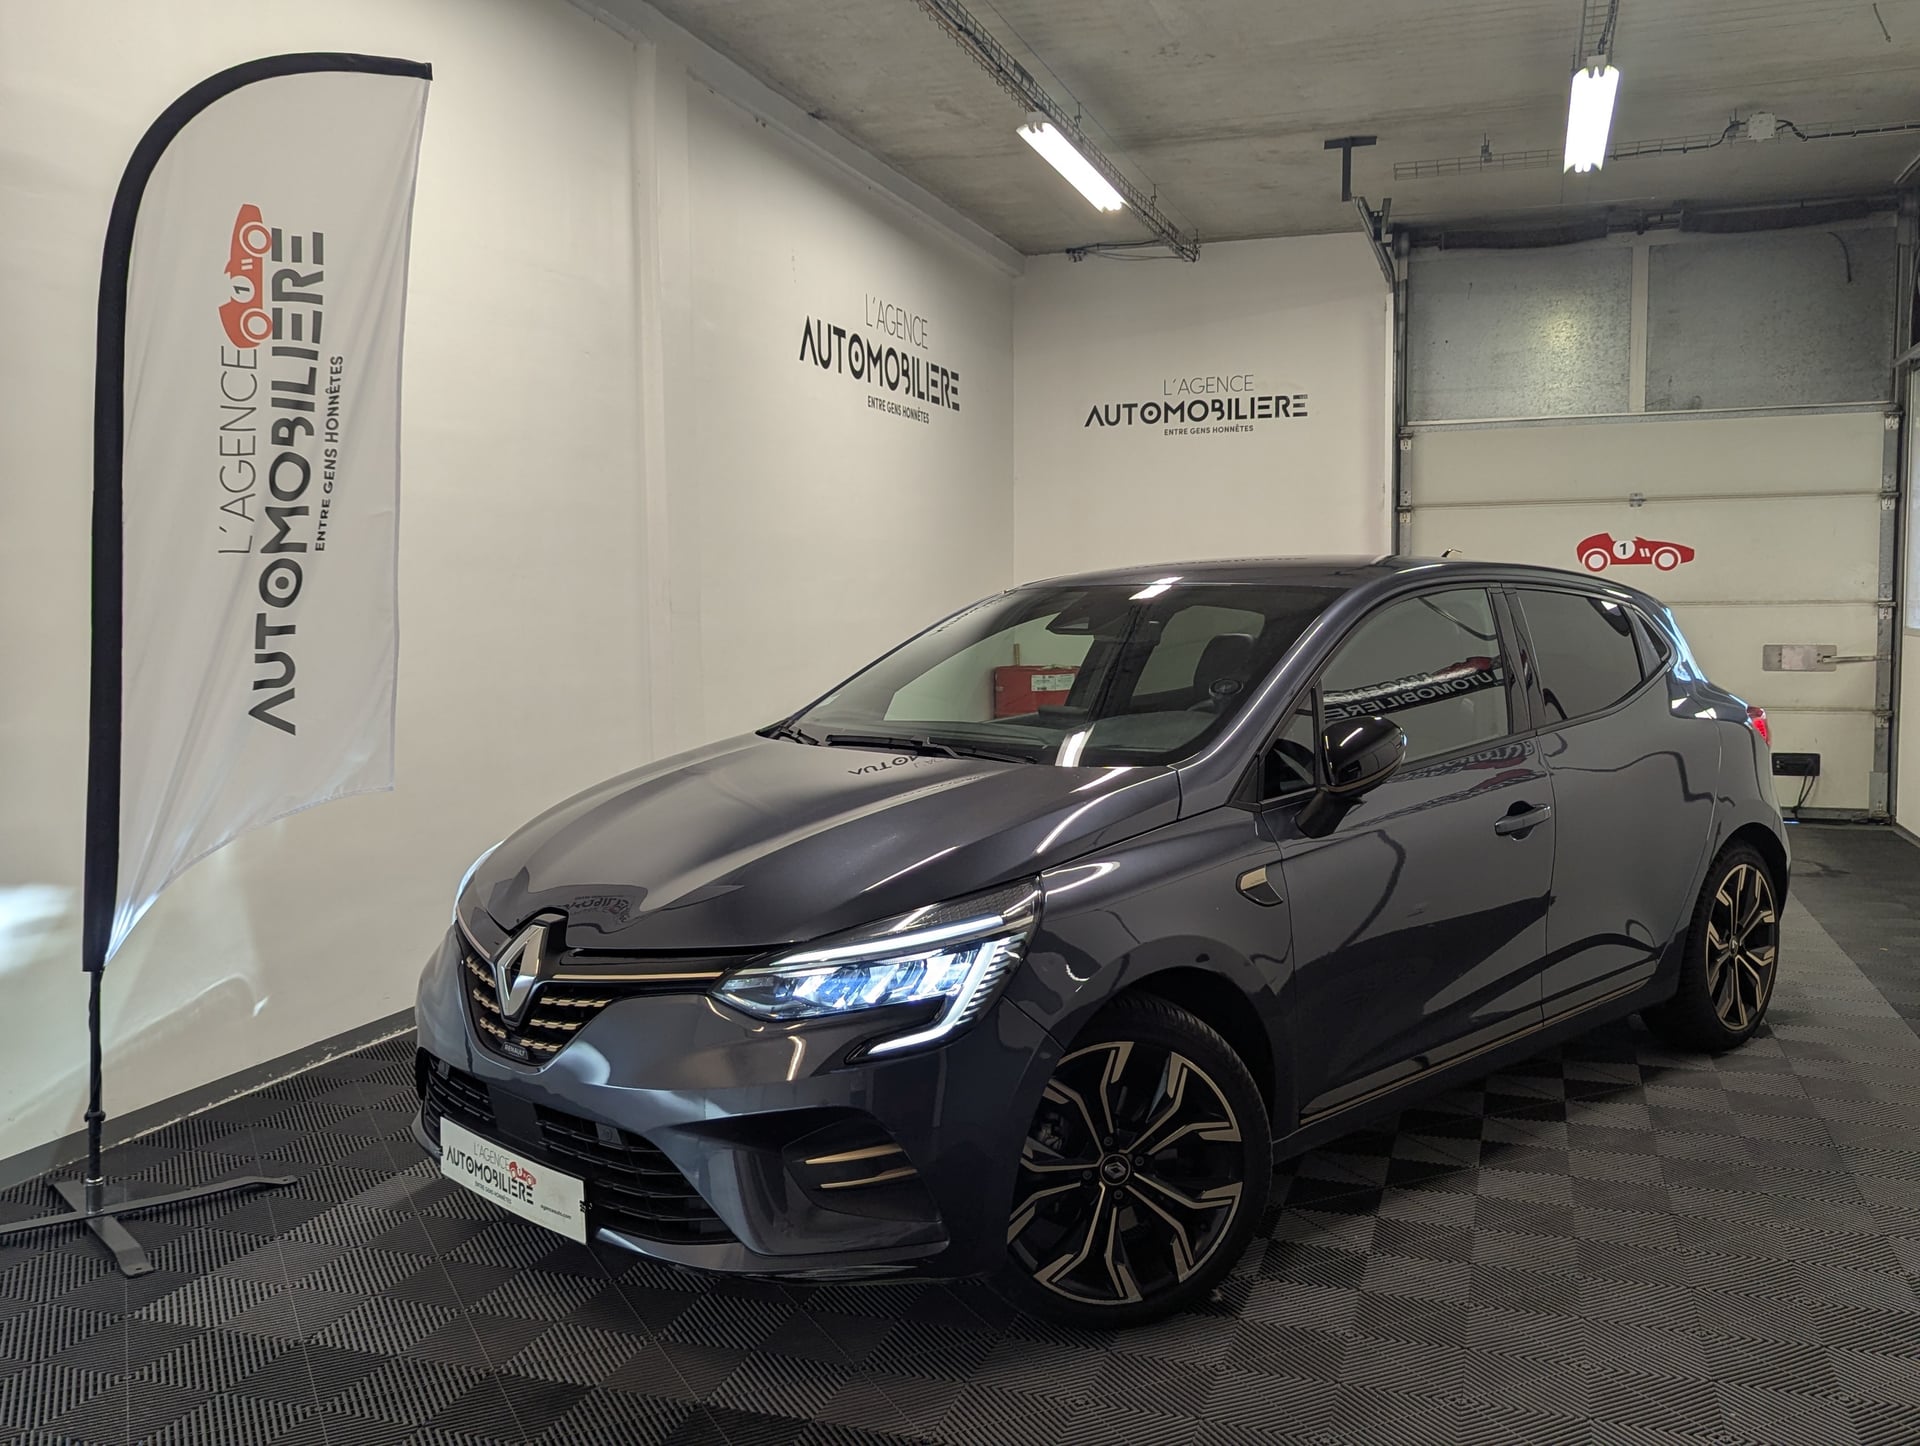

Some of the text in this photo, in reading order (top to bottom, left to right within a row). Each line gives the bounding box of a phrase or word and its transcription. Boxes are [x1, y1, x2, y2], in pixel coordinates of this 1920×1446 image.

[232, 285, 250, 294] 1
[865, 293, 928, 350] L'AGENCE
[799, 315, 960, 412] AUTOMOBILIERE
[1163, 374, 1254, 396] L'AGENCE
[867, 395, 930, 424] ENTRE GENS HONNÊTES
[1084, 394, 1308, 428] AUTOMOBILIERE
[1164, 424, 1254, 436] ENTRE GENS HONNÊTES
[218, 345, 258, 553] L'AGENCE
[315, 355, 344, 551] ENTRE GENS HONNÊTES
[247, 227, 324, 736] AUTOMOBILIERE
[1619, 543, 1627, 555] 1
[446, 1145, 534, 1205] AUTOMOBILIERE
